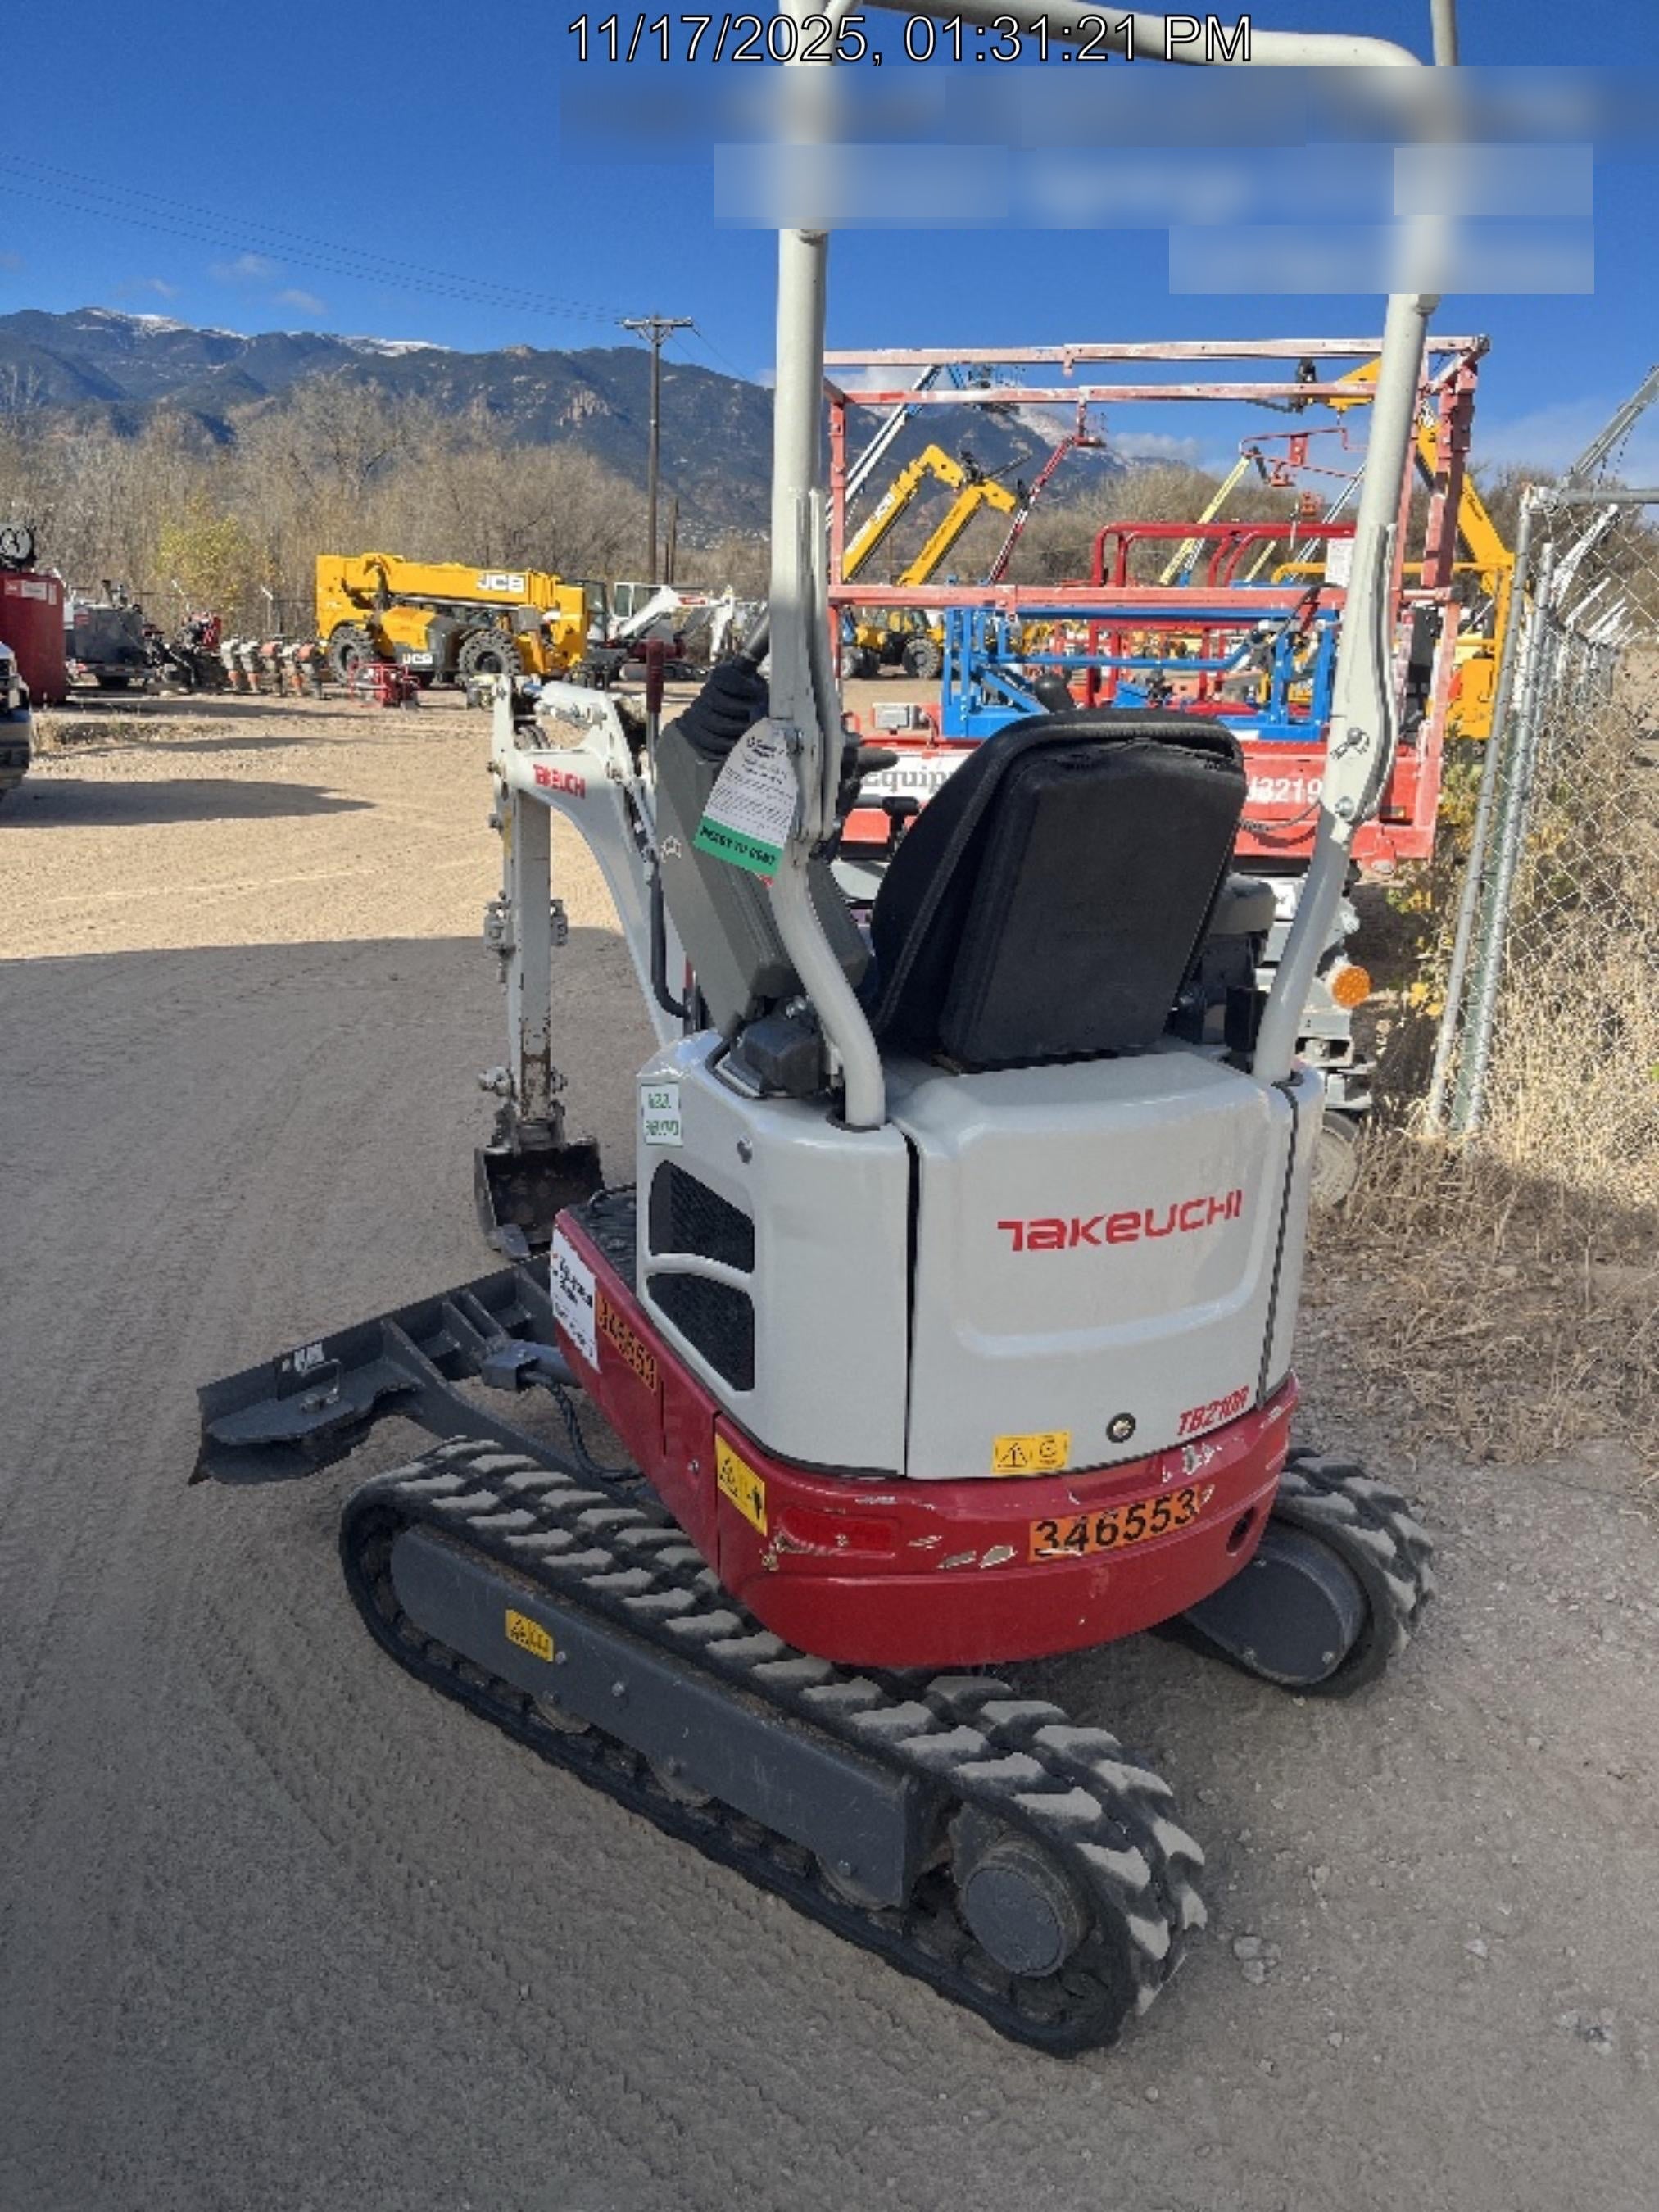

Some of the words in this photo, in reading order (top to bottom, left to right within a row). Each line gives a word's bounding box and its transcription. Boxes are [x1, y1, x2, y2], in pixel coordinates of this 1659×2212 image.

[476, 573, 526, 593] JCB
[863, 765, 952, 794] Equip
[997, 1189, 1242, 1251] TAKEUCHI
[1036, 1489, 1197, 1556] 346553
